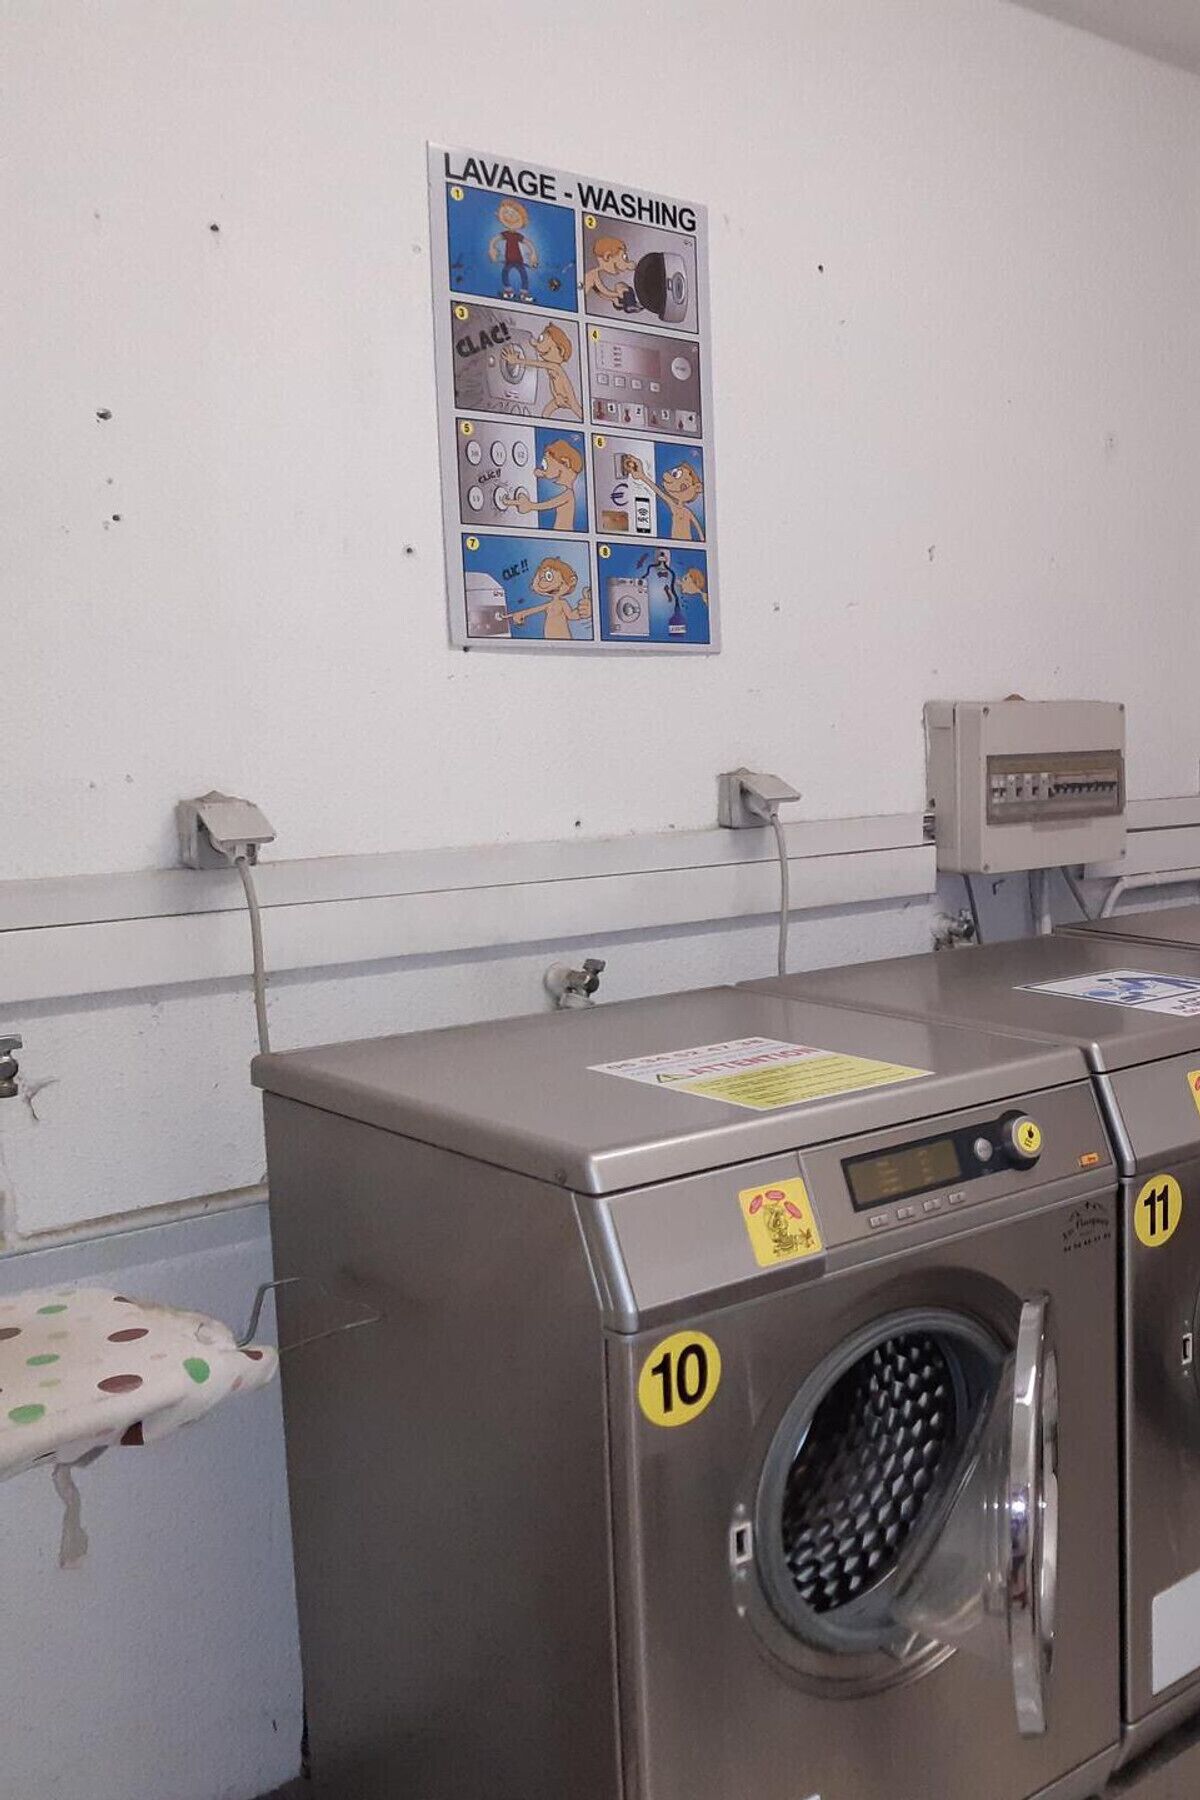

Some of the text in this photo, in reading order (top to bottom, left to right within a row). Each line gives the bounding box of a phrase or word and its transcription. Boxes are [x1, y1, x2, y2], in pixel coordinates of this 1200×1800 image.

[444, 152, 556, 200] LAVAGE
[577, 183, 697, 232] WASHING
[456, 322, 511, 358] CLAC!
[689, 1047, 817, 1075] ATTENTION
[1144, 1184, 1169, 1237] 11
[651, 1343, 708, 1415] 10
